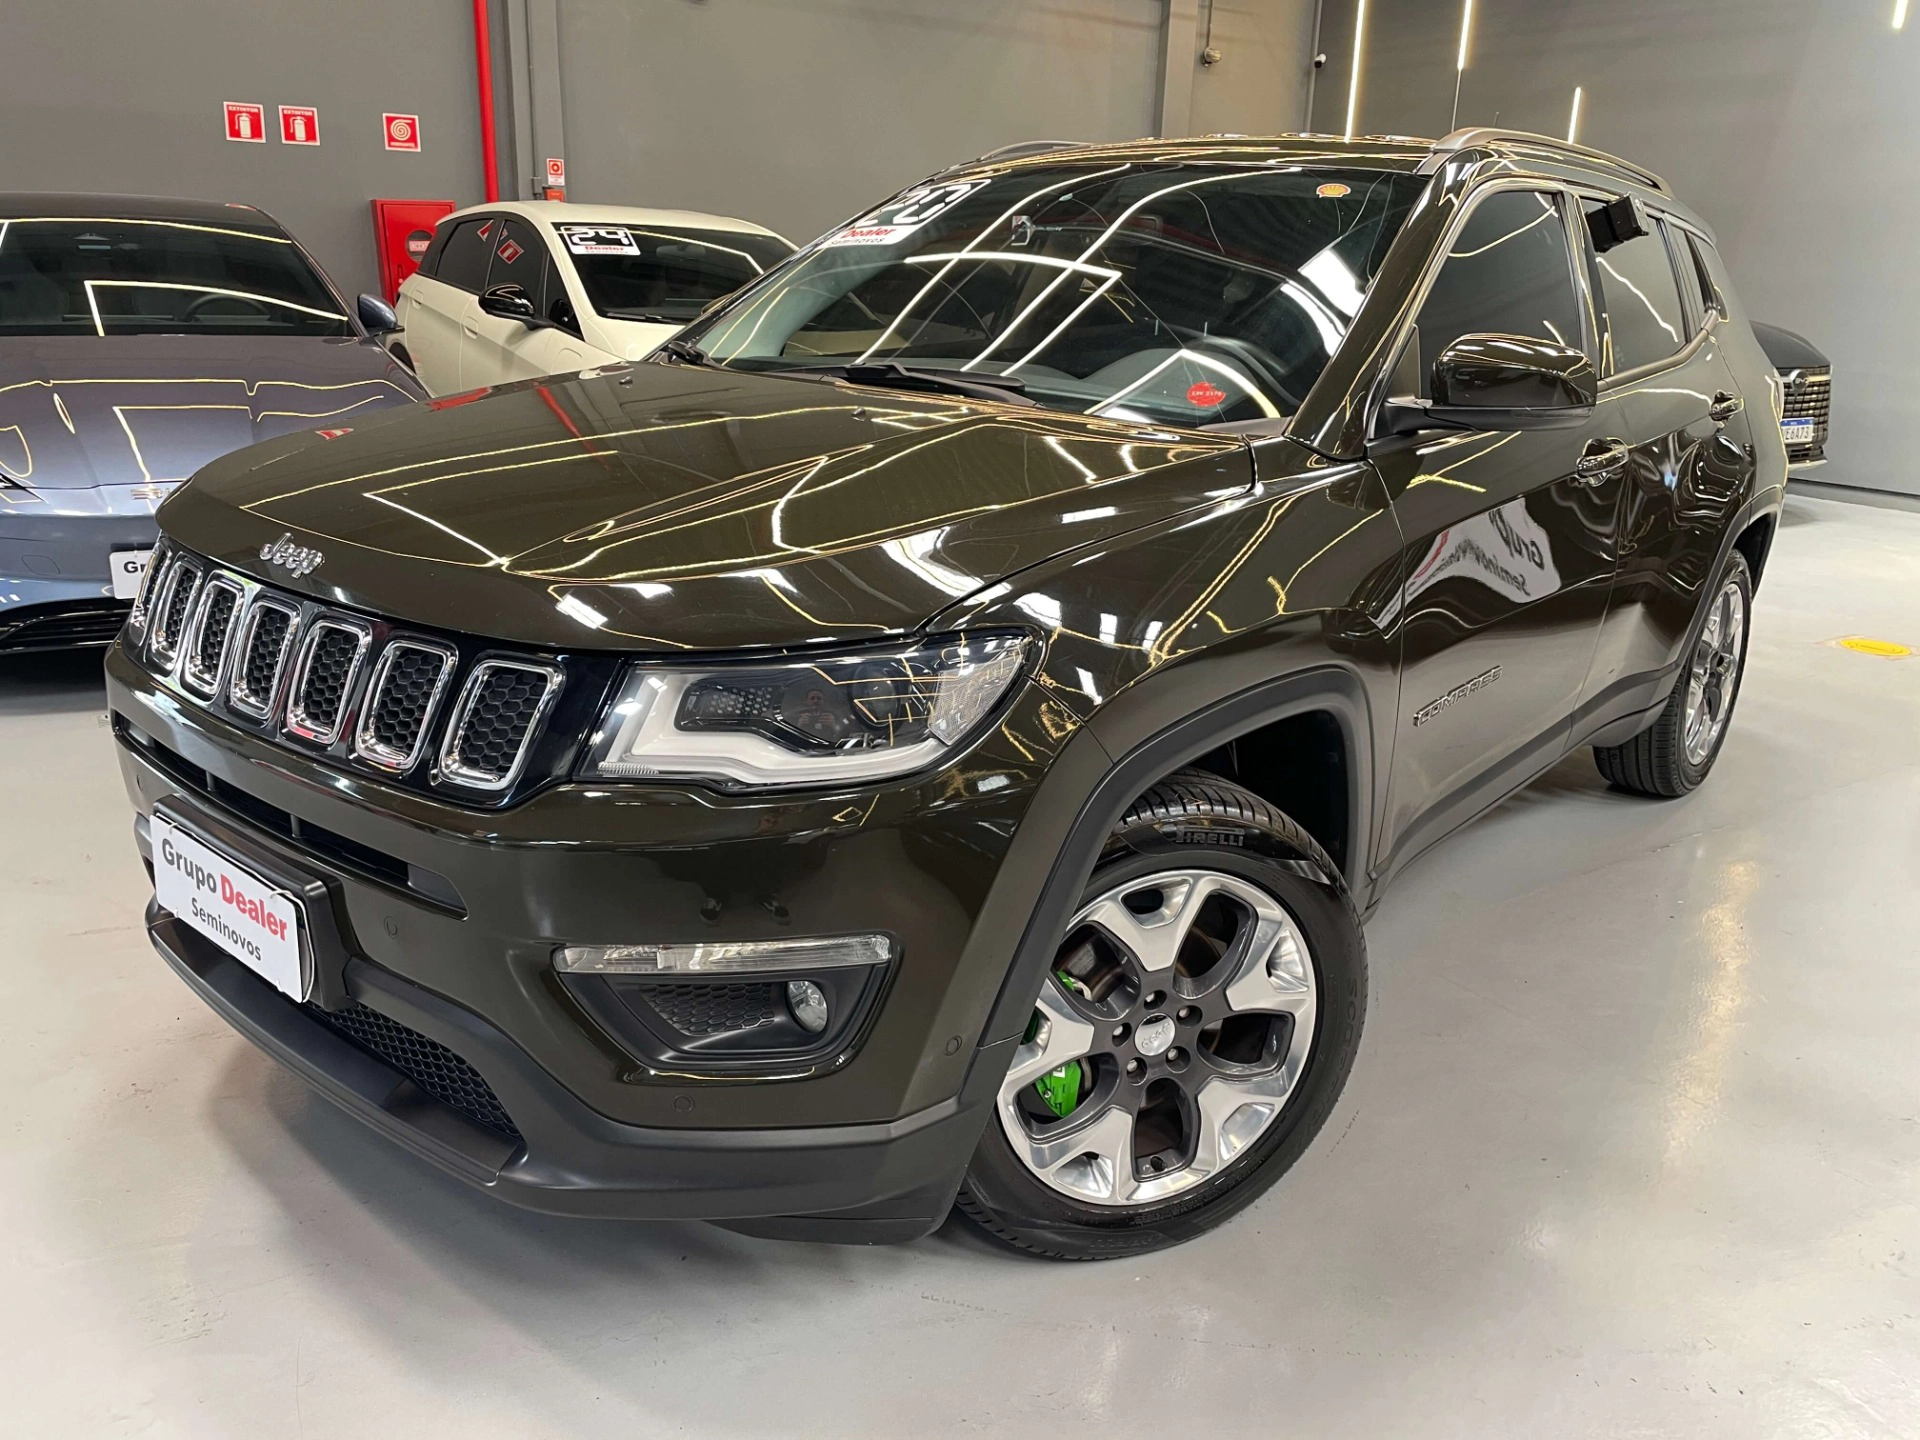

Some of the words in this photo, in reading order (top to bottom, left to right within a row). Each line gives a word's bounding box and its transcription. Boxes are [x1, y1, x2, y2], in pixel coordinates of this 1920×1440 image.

[841, 227, 896, 239] Dealer
[260, 532, 325, 579] Jeep
[1413, 665, 1503, 727] COMPASS
[1175, 825, 1245, 847] PIRELLI
[161, 838, 217, 894] Grupo
[220, 873, 287, 942] Dealer
[191, 897, 262, 962] Seminovos
